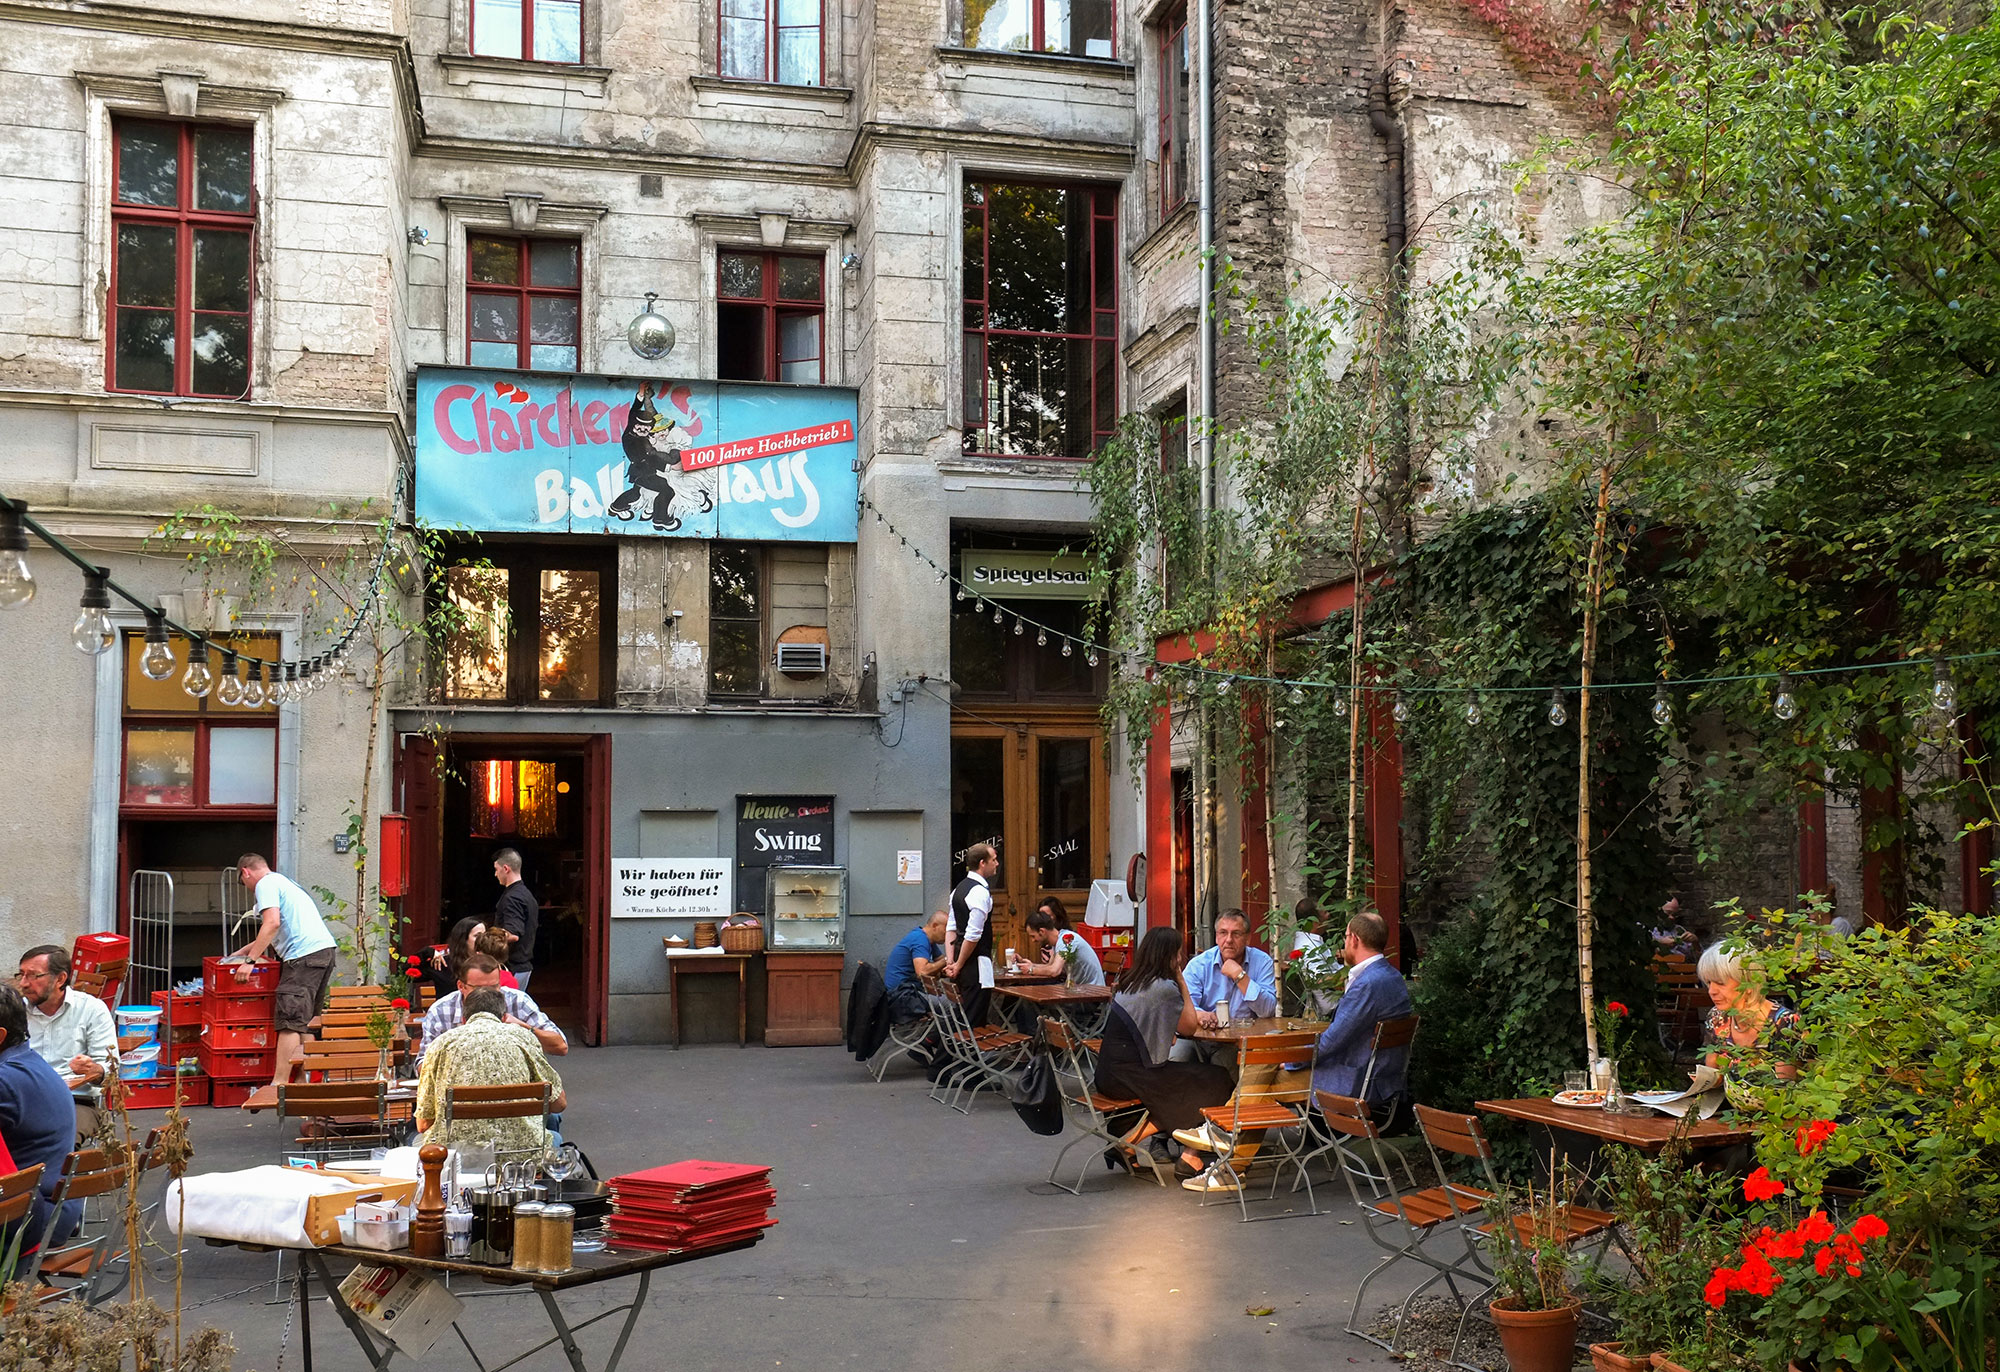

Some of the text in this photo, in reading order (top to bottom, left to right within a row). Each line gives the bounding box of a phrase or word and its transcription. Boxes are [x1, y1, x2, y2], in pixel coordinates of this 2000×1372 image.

[689, 449, 715, 466] 100
[716, 444, 754, 464] Jahre
[757, 425, 839, 453] Hochbetrieb
[753, 827, 822, 851] Swing
[620, 868, 723, 881] Wir haben für
[622, 884, 719, 899] Sie geöffnet!
[656, 905, 677, 913] Küche
